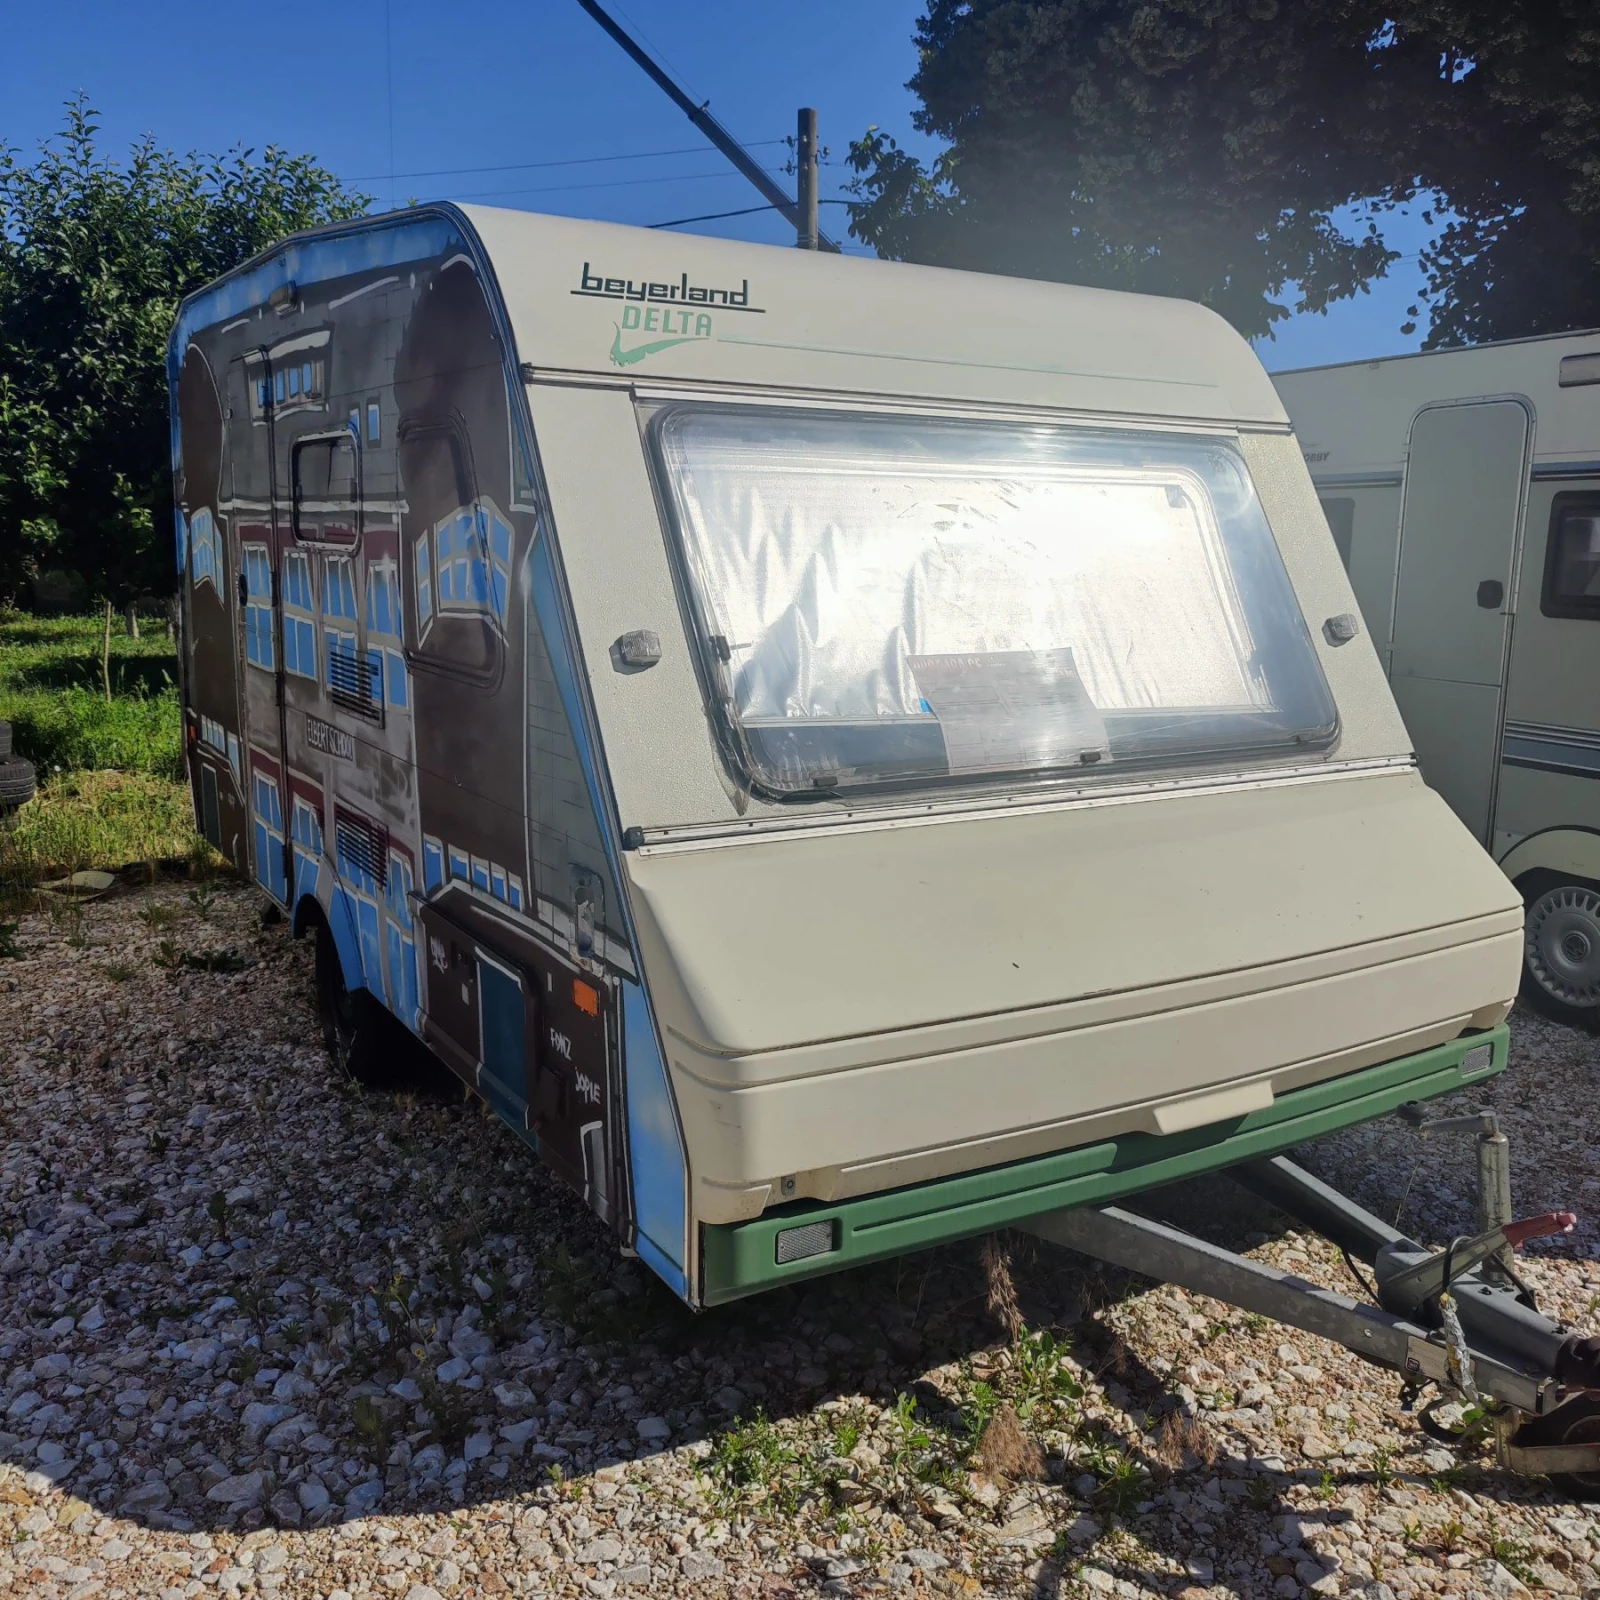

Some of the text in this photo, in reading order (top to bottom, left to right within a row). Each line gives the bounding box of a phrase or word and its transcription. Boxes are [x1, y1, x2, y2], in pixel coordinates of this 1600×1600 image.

[581, 262, 748, 306] beyerland
[622, 305, 713, 337] DELTA
[1304, 451, 1331, 462] OBBY
